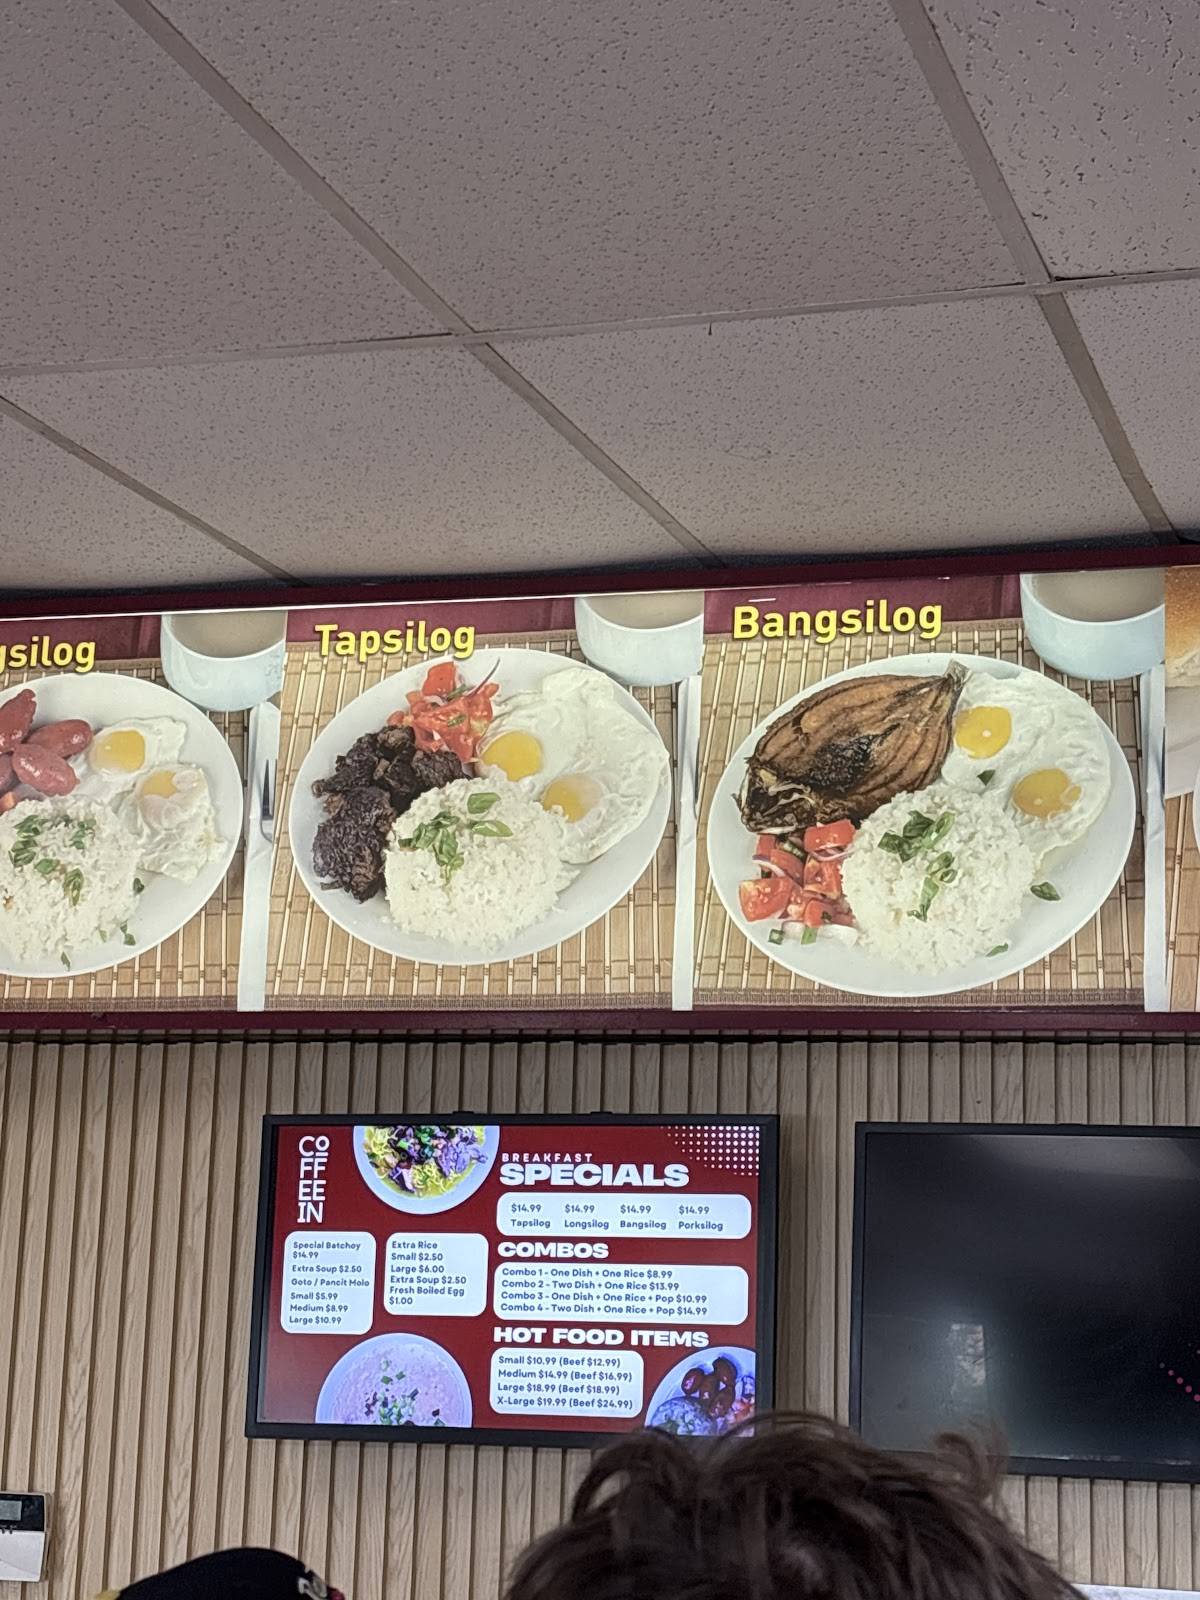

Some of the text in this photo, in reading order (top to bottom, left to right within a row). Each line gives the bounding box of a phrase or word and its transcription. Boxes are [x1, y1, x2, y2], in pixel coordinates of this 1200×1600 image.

[733, 600, 943, 643] Bangsilog
[314, 621, 476, 663] Tapsilog
[501, 1153, 593, 1163] BREAKFAST
[499, 1163, 690, 1187] SPECIALS
[511, 1203, 710, 1215] $14.99 $14.99 $14.99 $14.99
[510, 1218, 724, 1231] Tapsilog Longsilog Bangsilog Porksilog
[293, 1241, 361, 1250] Special Batchoy
[392, 1240, 438, 1249] Extra Rice
[293, 1251, 319, 1259] $14.99
[498, 1242, 609, 1259] COMBOS
[391, 1252, 443, 1261] Small $2.50
[316, 1265, 337, 1274] Soup
[339, 1265, 362, 1273] $2.50
[391, 1265, 444, 1274] Large $6.00
[502, 1268, 536, 1276] Combo
[572, 1268, 593, 1277] Dish
[602, 1269, 621, 1277] One
[624, 1269, 644, 1278] Rice
[647, 1270, 672, 1279] $8.99
[291, 1278, 312, 1286] Goto
[416, 1276, 439, 1285] Soup
[442, 1276, 466, 1284] $2.50
[502, 1279, 536, 1288] Combo
[538, 1280, 544, 1288] 2
[575, 1281, 595, 1289] Dish
[605, 1281, 624, 1289] One
[626, 1281, 647, 1290] Rice
[649, 1282, 679, 1291] $13.99
[291, 1292, 338, 1300] Small $5.99
[390, 1286, 465, 1296] Fresh Boiled Egg
[389, 1296, 413, 1305] $1.00
[501, 1291, 536, 1299] Combo
[551, 1292, 570, 1300] One
[573, 1292, 593, 1300] Dish
[603, 1293, 622, 1301] One
[625, 1293, 646, 1302] Rice
[656, 1295, 674, 1304] Pop
[676, 1294, 707, 1303] $10.99
[290, 1304, 348, 1312] Medium $8.99
[500, 1303, 535, 1311] Combo
[551, 1304, 571, 1312] Two
[574, 1304, 594, 1312] Dish
[626, 1306, 646, 1314] Rice
[656, 1307, 675, 1316] Pop
[677, 1307, 708, 1315] $14.99
[289, 1316, 342, 1325] Large $10.99
[493, 1327, 709, 1348] HOT FOOD ITEMS
[498, 1356, 621, 1368] Small $10.99 (Beef $12.99)
[498, 1369, 632, 1382] Medium $14.99 (Beef $16.99)
[498, 1383, 620, 1395] Large $18.99 (Beef $18.99)
[497, 1396, 633, 1409] X-Large $19.99 (Beef $24.99)
